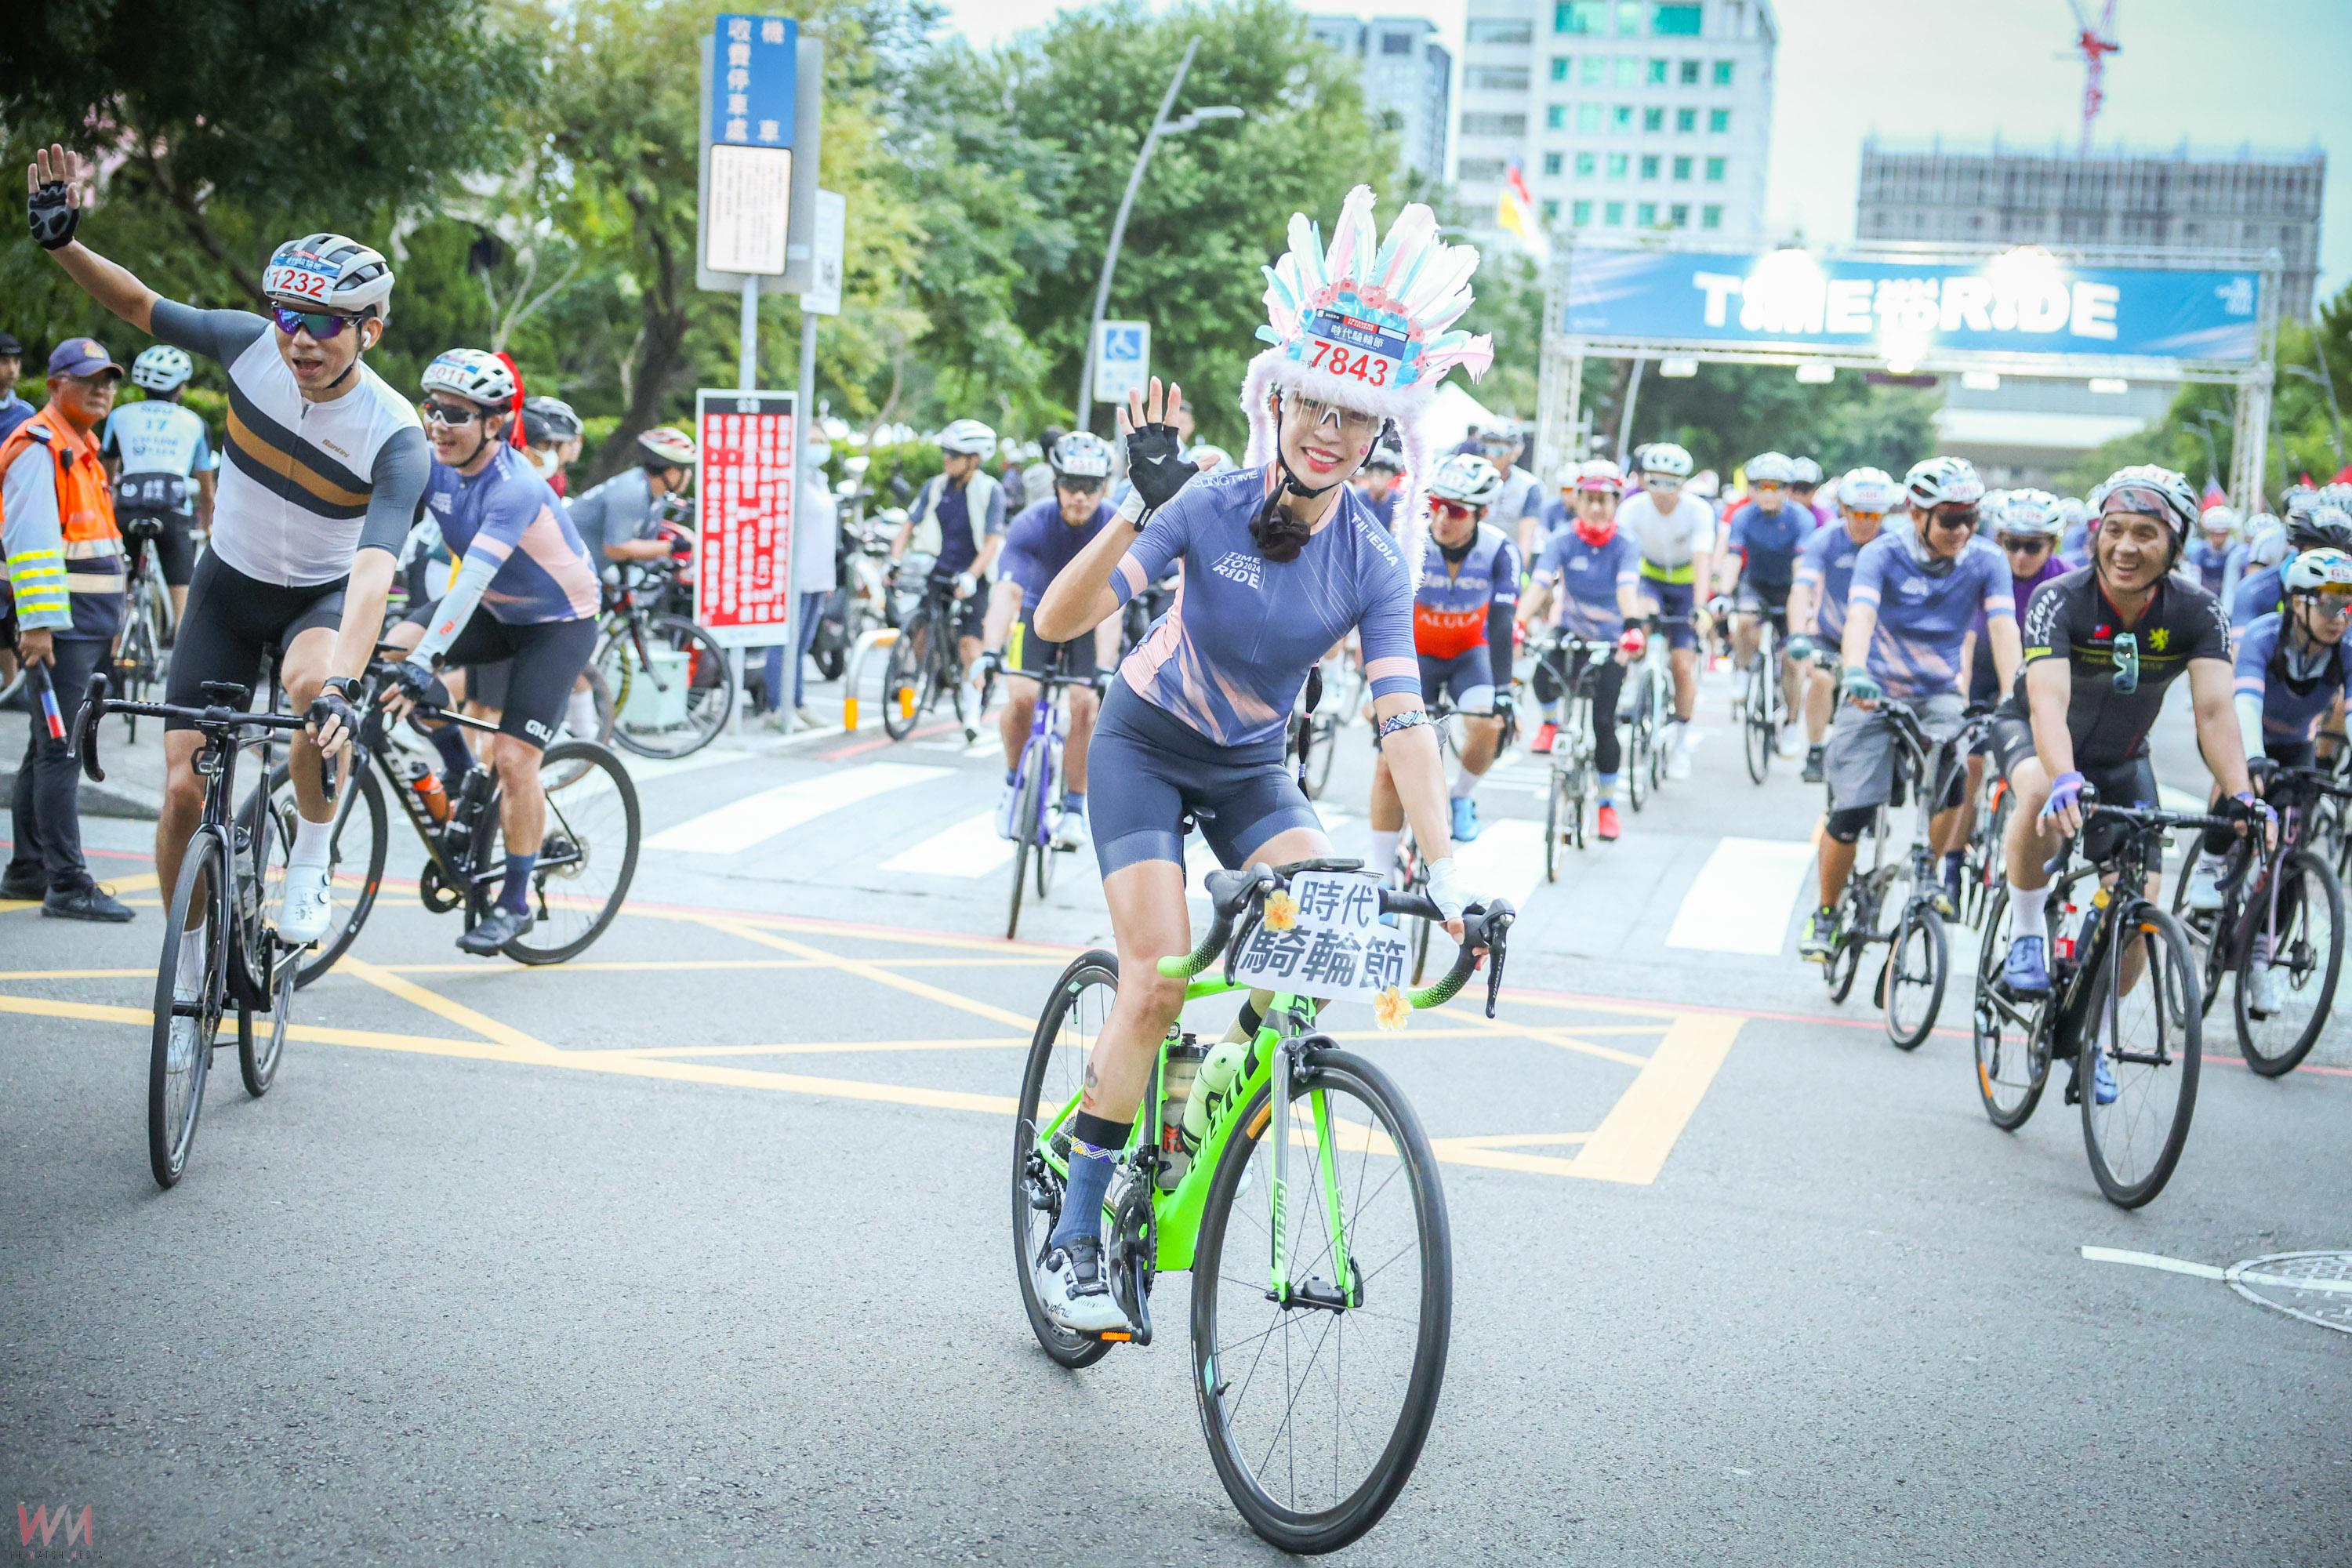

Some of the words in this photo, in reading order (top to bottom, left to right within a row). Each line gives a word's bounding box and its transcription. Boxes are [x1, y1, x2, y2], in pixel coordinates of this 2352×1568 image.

[272, 268, 326, 298] 1232
[1311, 340, 1388, 387] 7843
[1221, 557, 1245, 569] TO
[1244, 561, 1261, 574] 2024
[1299, 880, 1376, 928] 時代
[1239, 925, 1406, 993] 騎輪節
